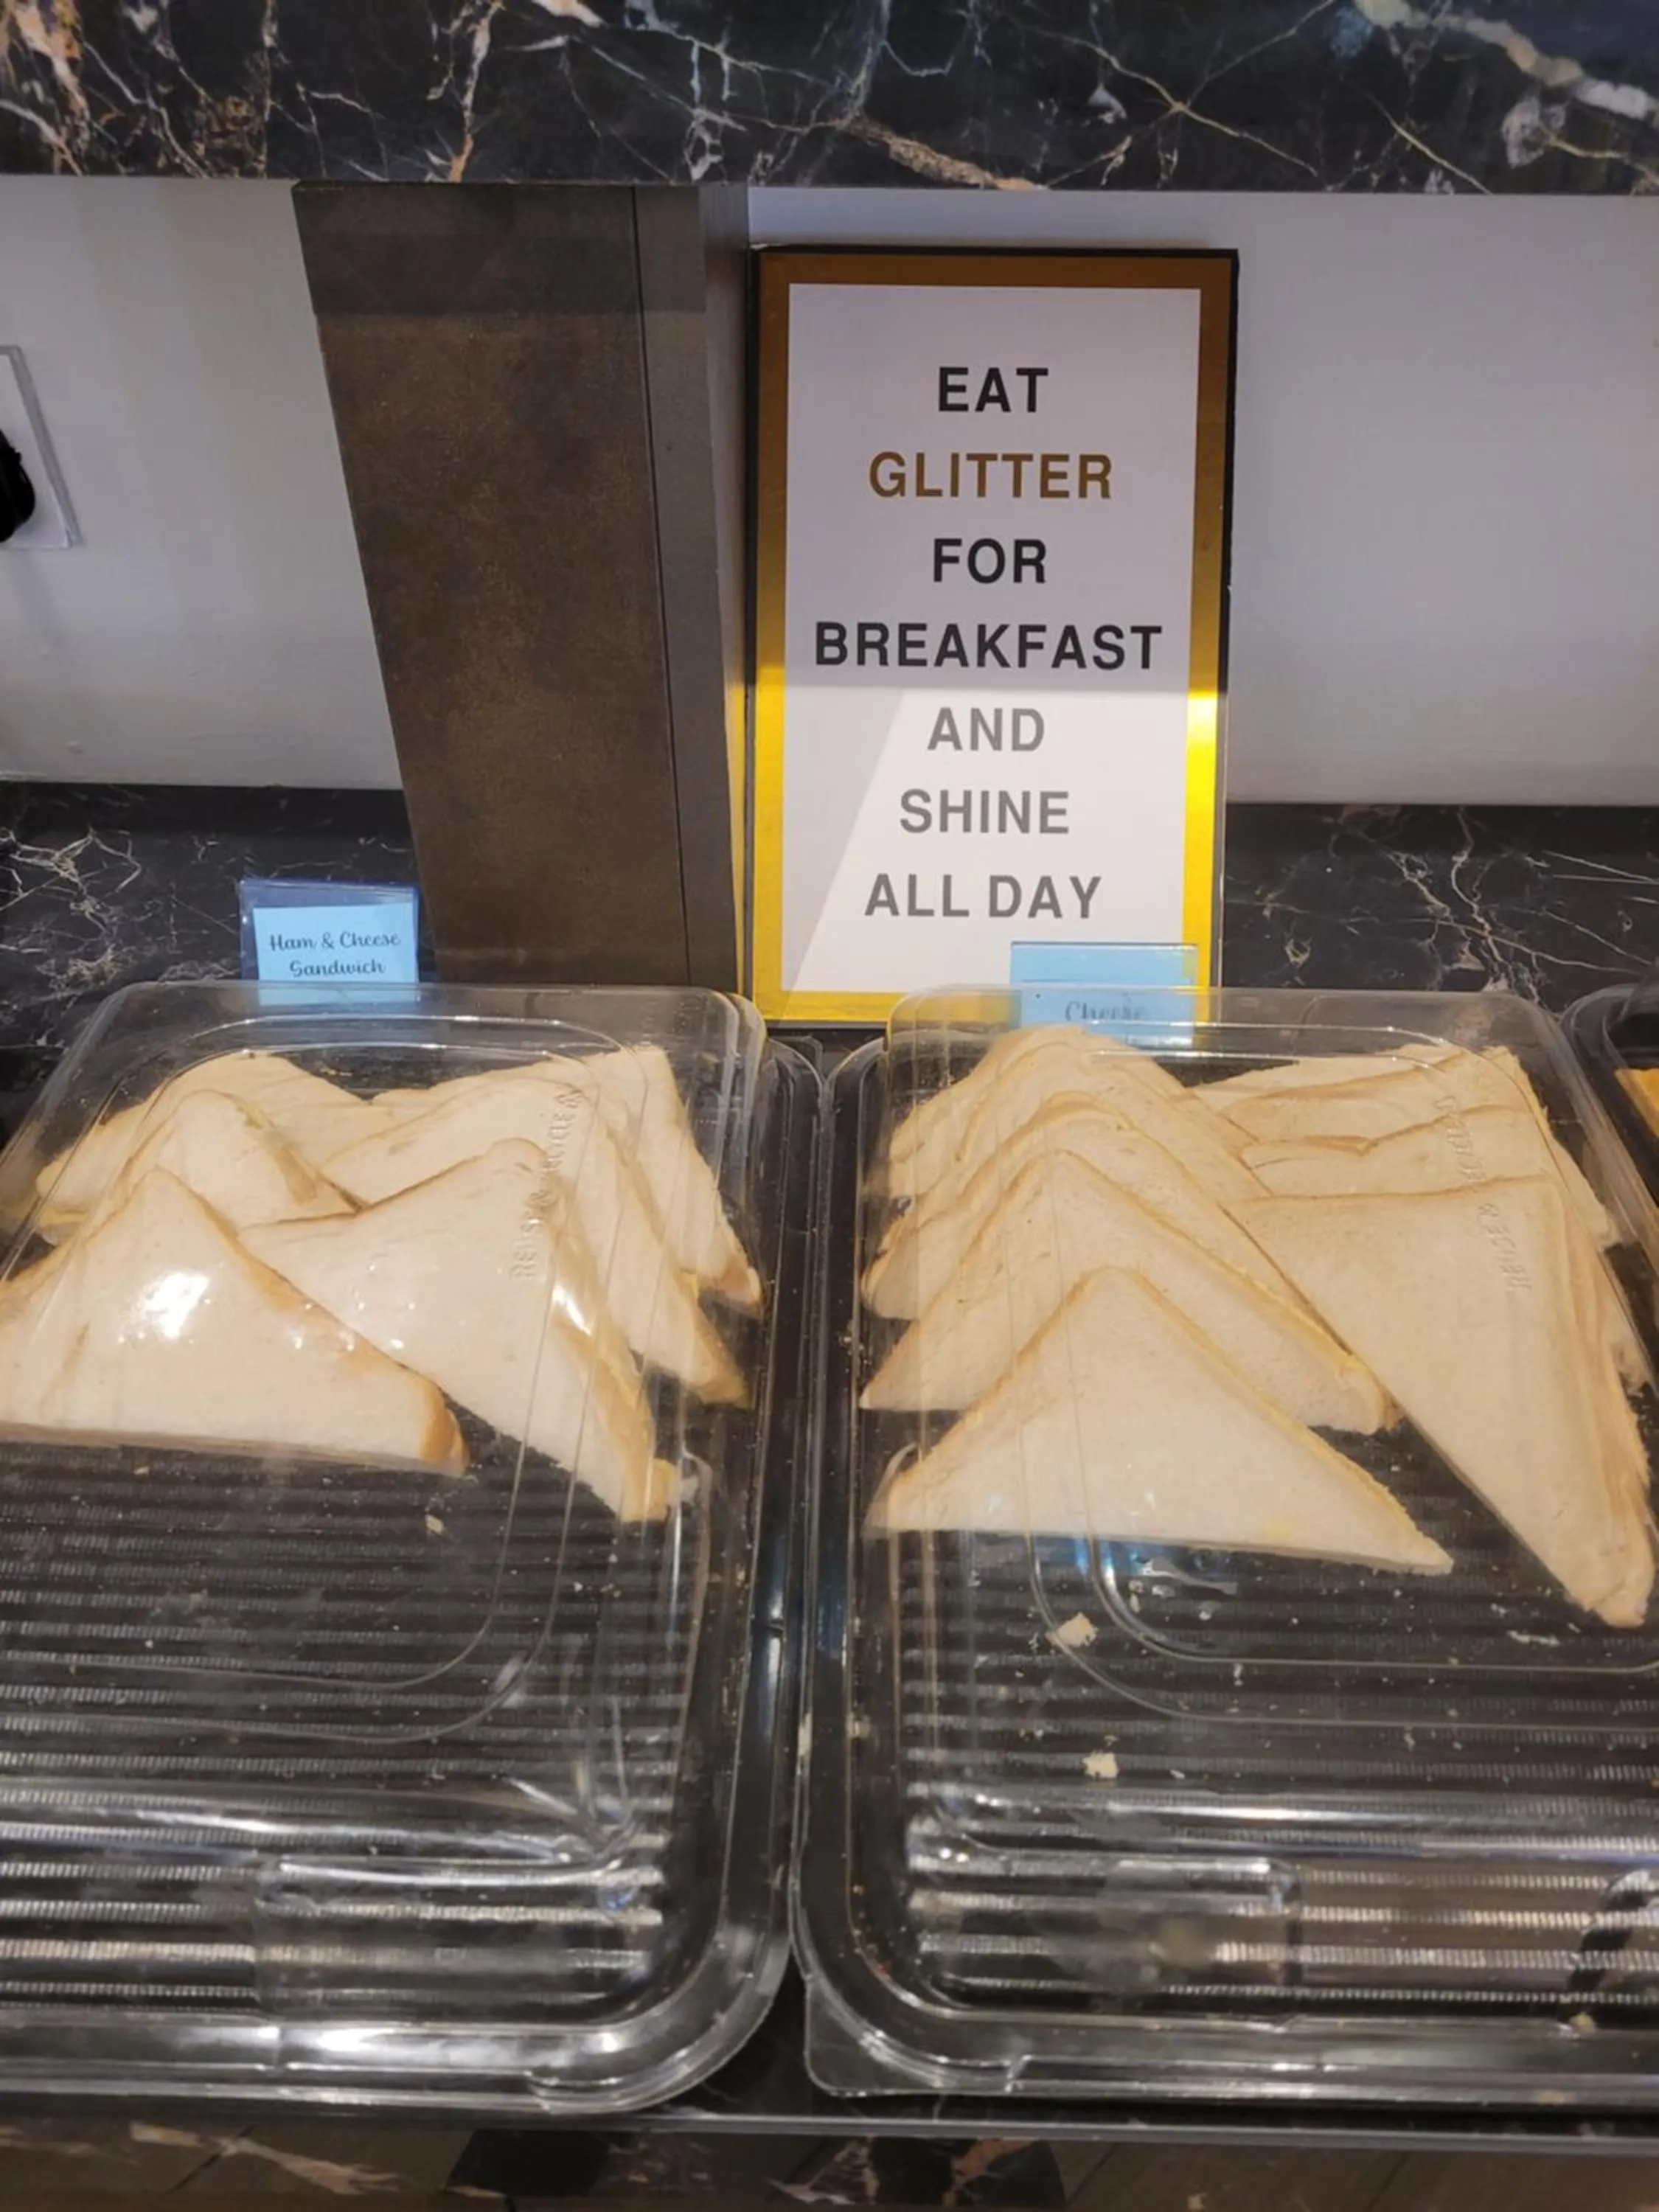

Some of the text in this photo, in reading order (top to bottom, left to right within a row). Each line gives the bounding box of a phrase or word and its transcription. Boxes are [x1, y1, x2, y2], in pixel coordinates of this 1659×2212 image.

[939, 366, 1048, 413] EAT
[869, 451, 1111, 499] GLITTER
[933, 538, 1046, 584] FOR
[815, 621, 1162, 670] BREAKFAST
[928, 707, 1044, 751] AND
[900, 788, 1069, 834] SHINE
[865, 873, 1101, 919] ALL DAY
[269, 931, 403, 952] Ham & Cheese
[289, 959, 386, 978] Sandwich
